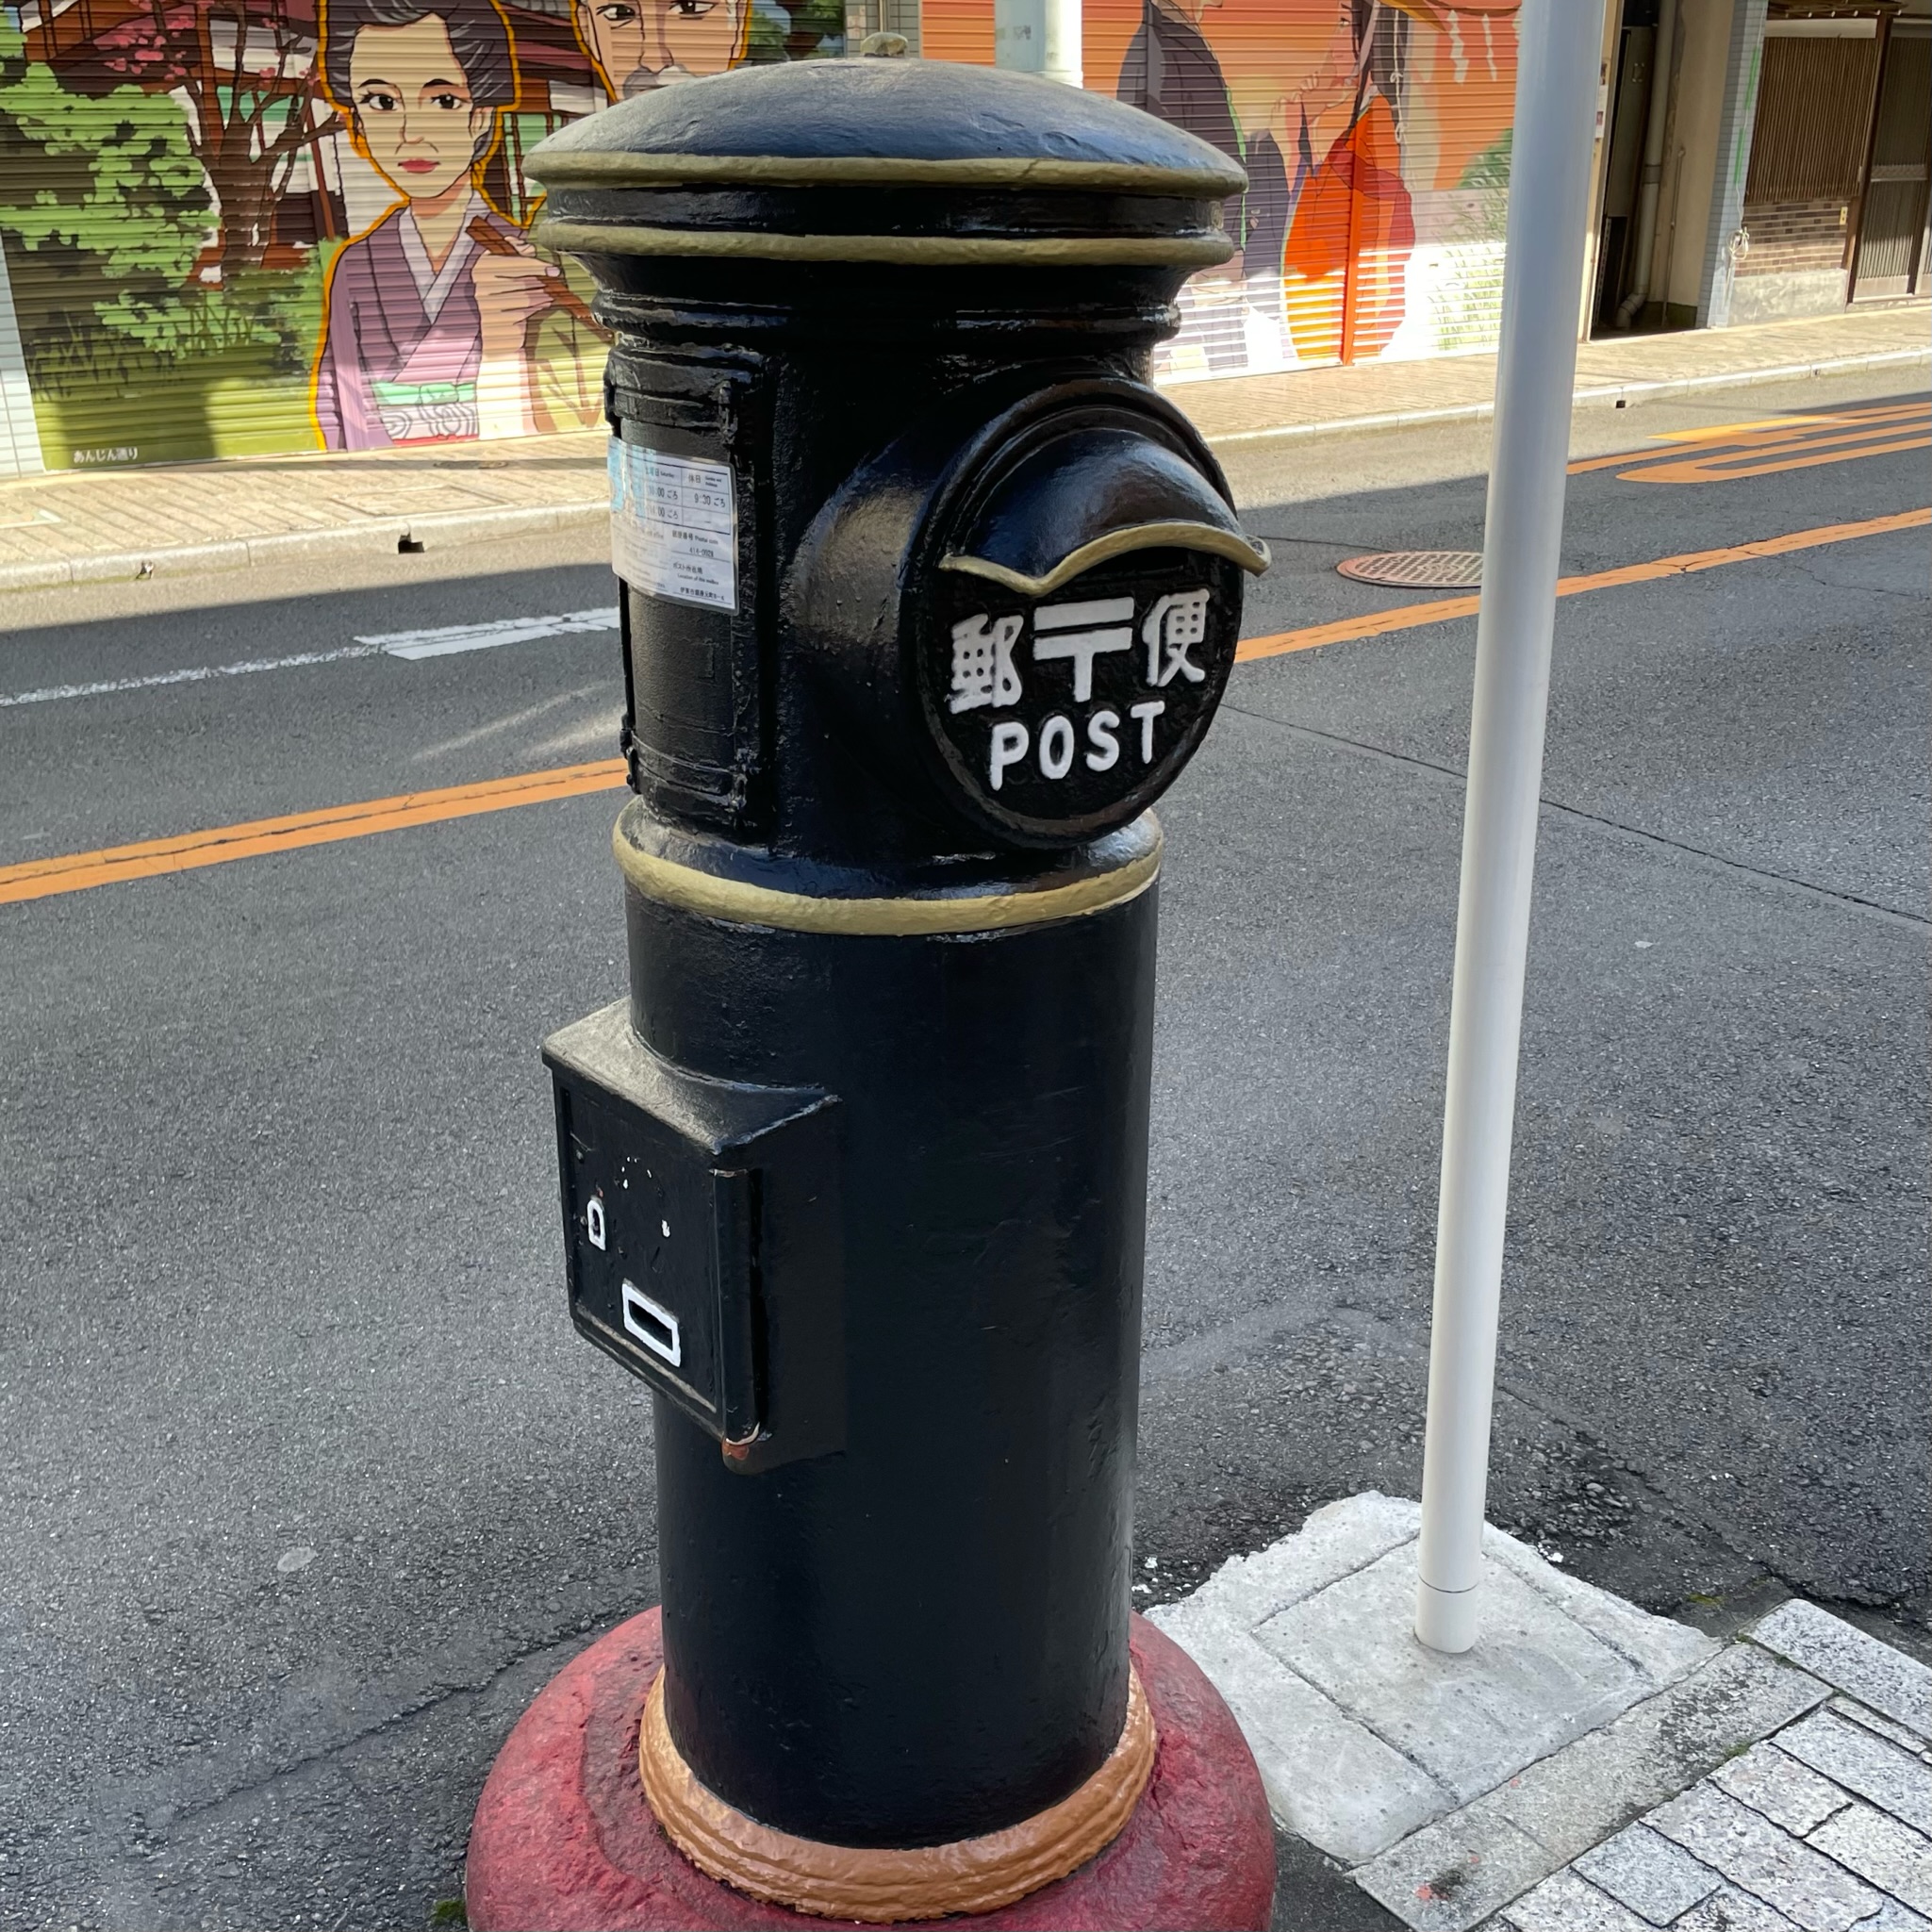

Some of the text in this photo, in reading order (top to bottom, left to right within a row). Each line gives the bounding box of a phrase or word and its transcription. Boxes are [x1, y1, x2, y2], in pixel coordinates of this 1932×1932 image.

[74, 447, 138, 463] あんじん通り
[694, 493, 726, 507] 9:30 ごろ
[990, 701, 1165, 791] POST
